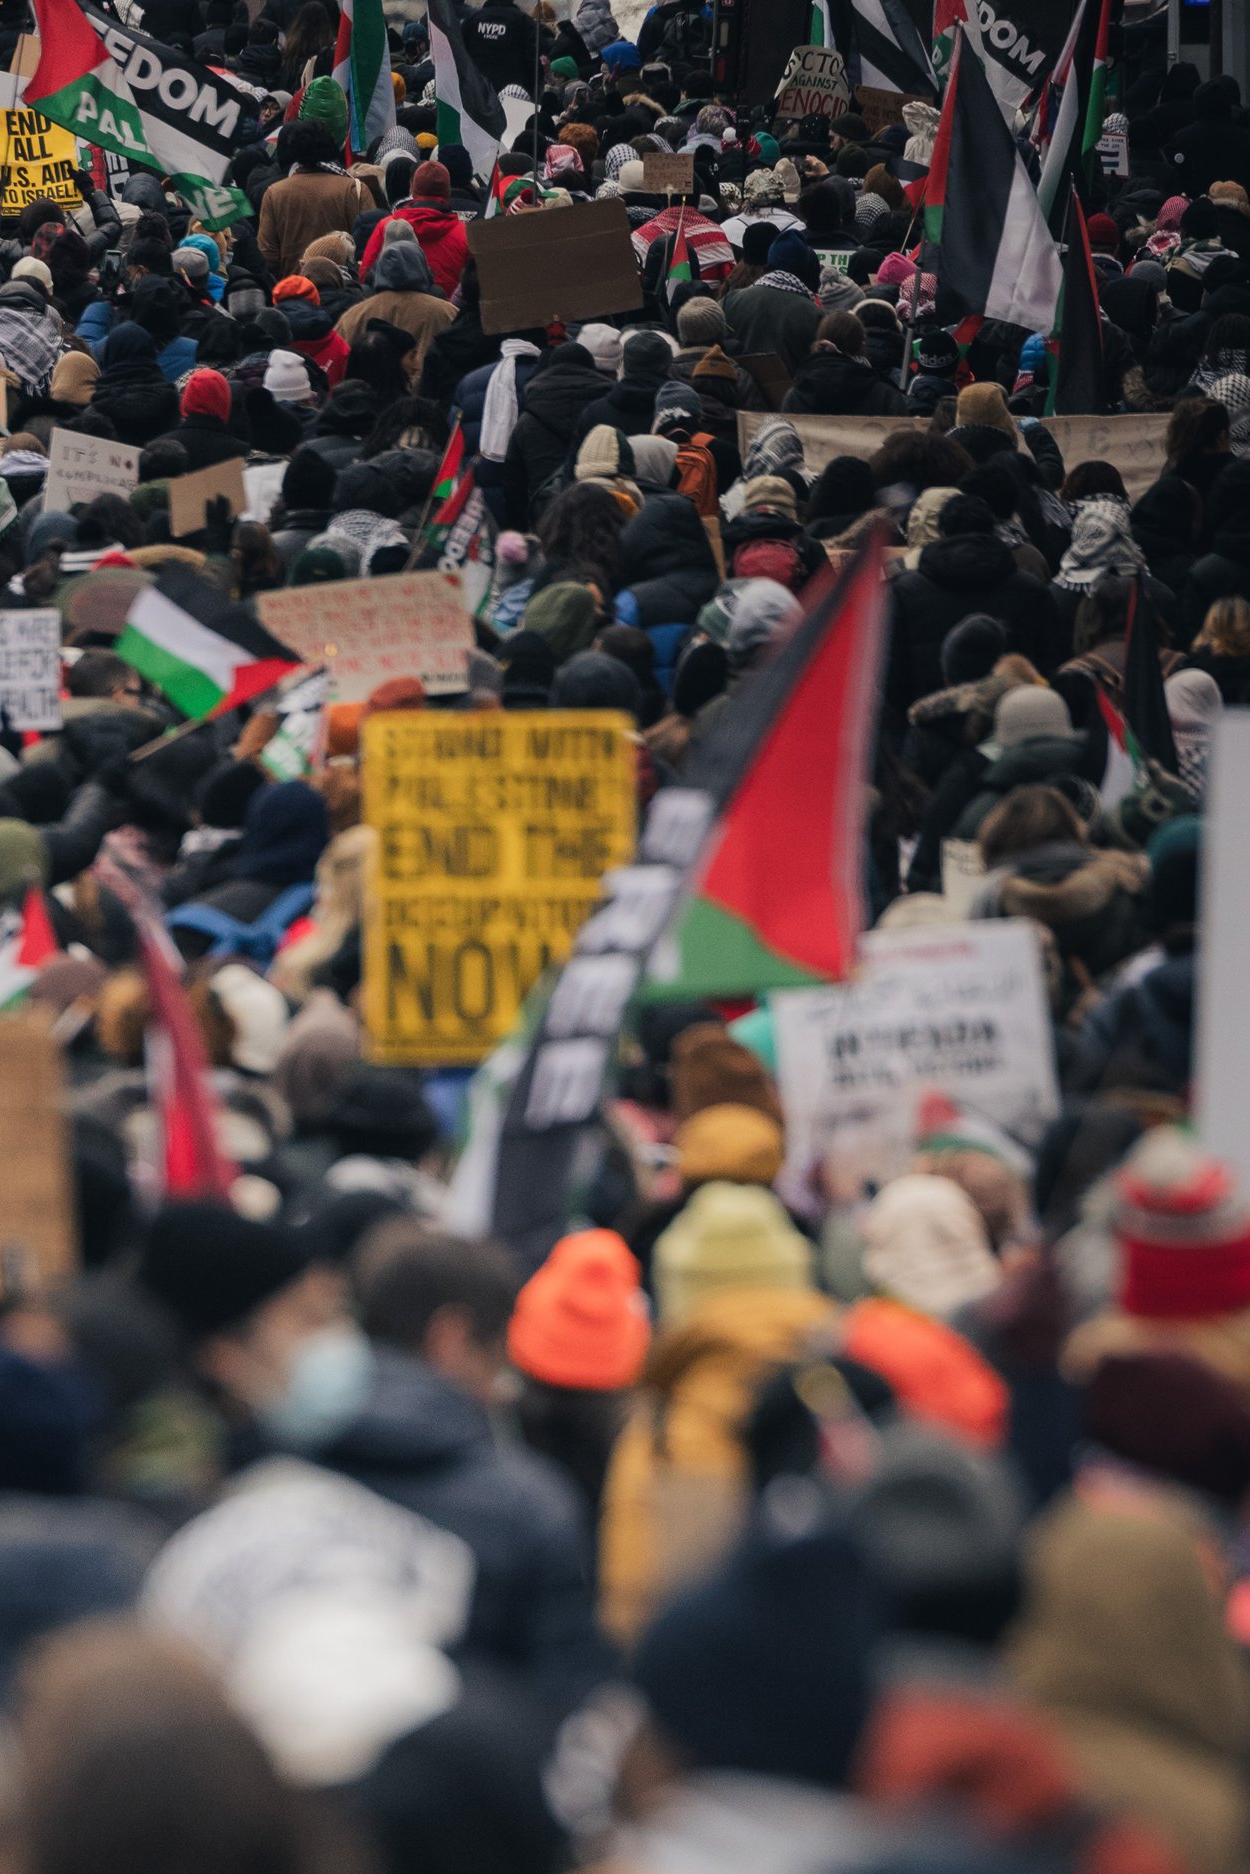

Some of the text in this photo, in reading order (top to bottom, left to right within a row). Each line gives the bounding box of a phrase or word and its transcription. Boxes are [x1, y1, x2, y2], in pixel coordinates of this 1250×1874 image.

[477, 22, 506, 36] NYPD
[790, 72, 838, 90] AGAINST
[6, 111, 51, 136] END
[14, 136, 53, 161] ALL
[42, 160, 74, 186] AID
[22, 181, 79, 205] ISRAEL!
[385, 821, 616, 880] END THE
